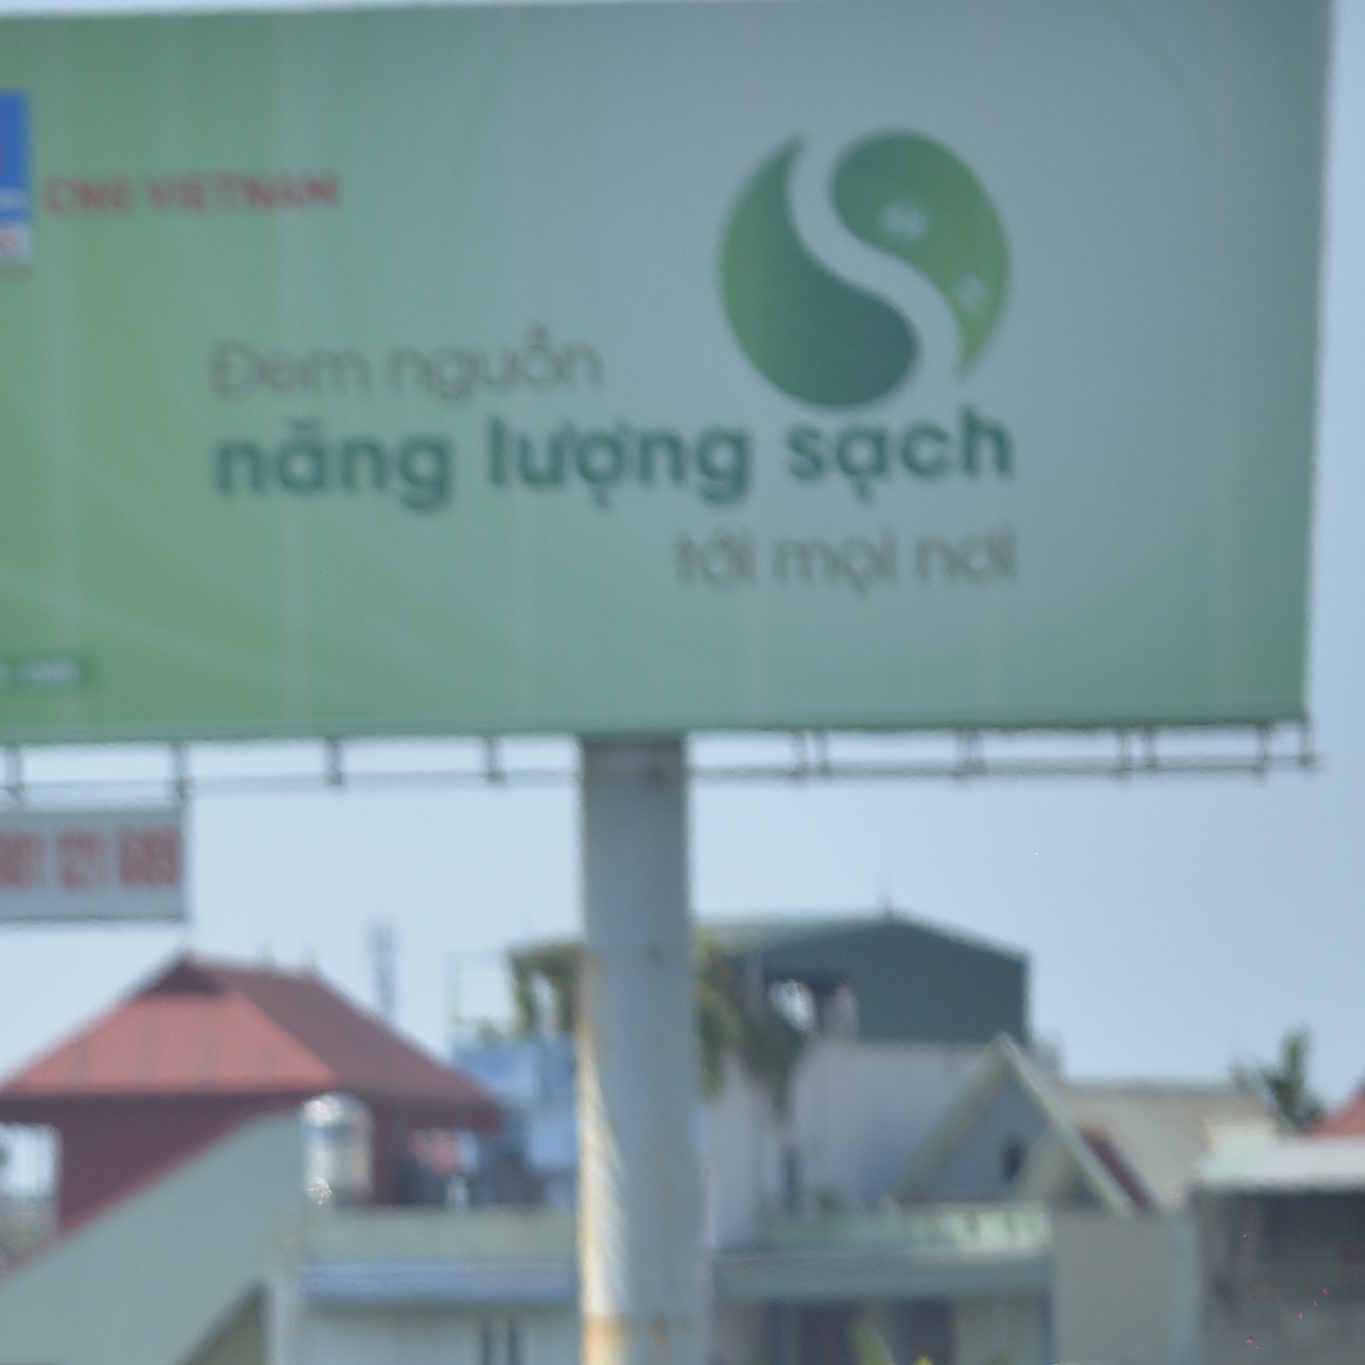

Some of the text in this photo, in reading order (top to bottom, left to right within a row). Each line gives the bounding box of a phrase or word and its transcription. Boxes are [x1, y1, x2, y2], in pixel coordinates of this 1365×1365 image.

[148, 171, 340, 213] VIETNAM
[212, 340, 370, 398] Đem
[215, 404, 1014, 512] năng lượng sạch
